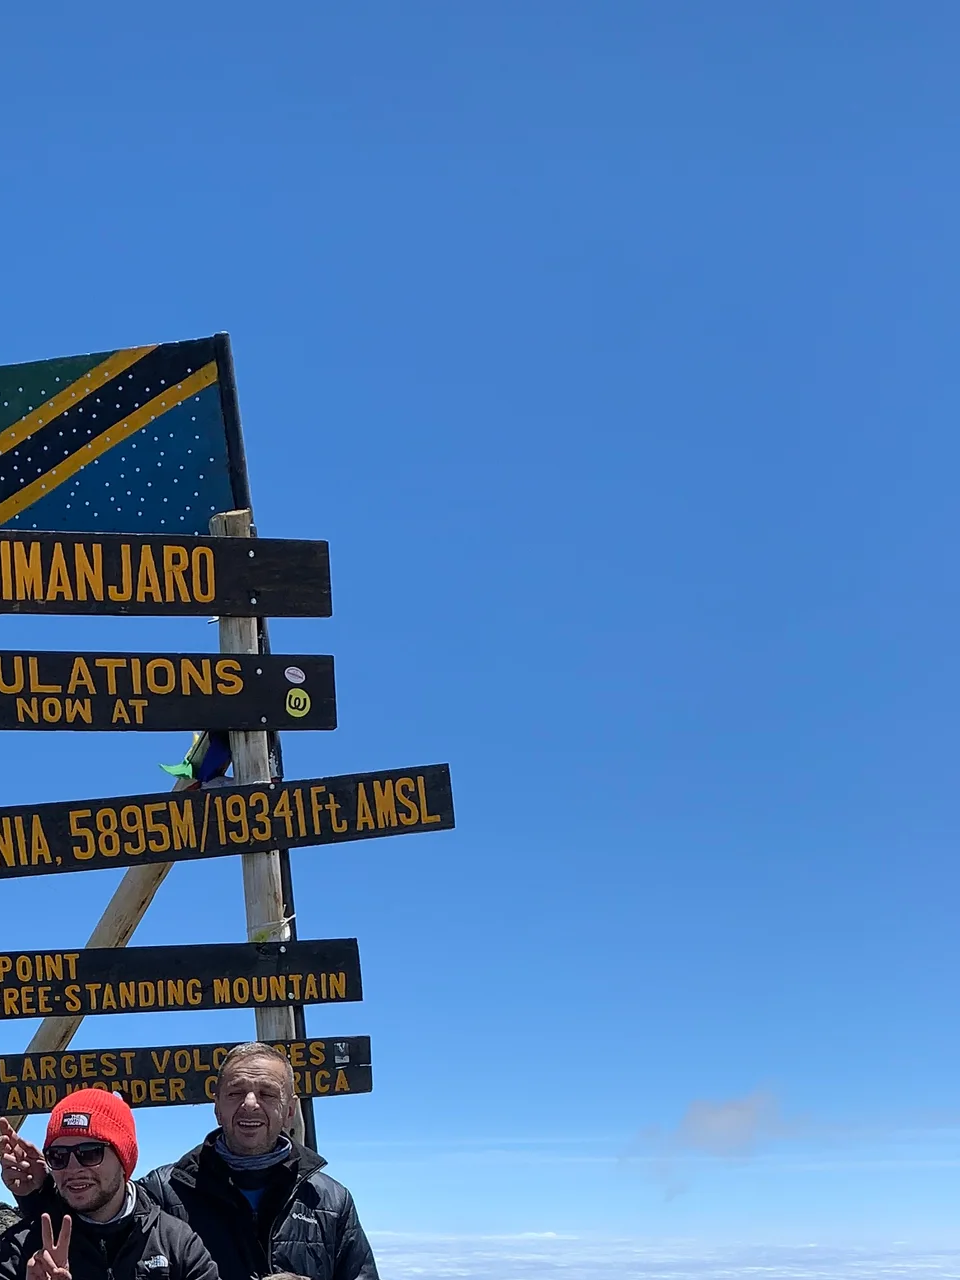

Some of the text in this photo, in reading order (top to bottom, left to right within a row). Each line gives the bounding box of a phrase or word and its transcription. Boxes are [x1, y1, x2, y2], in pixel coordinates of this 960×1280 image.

[16, 698, 92, 724] NOW
[112, 699, 148, 724] AT
[356, 776, 441, 830] AMSL
[213, 972, 346, 1004] MOUNTAIN
[0, 1052, 137, 1082] LARGEST
[151, 1041, 326, 1075] VOLCES
[7, 1084, 57, 1112] AND
